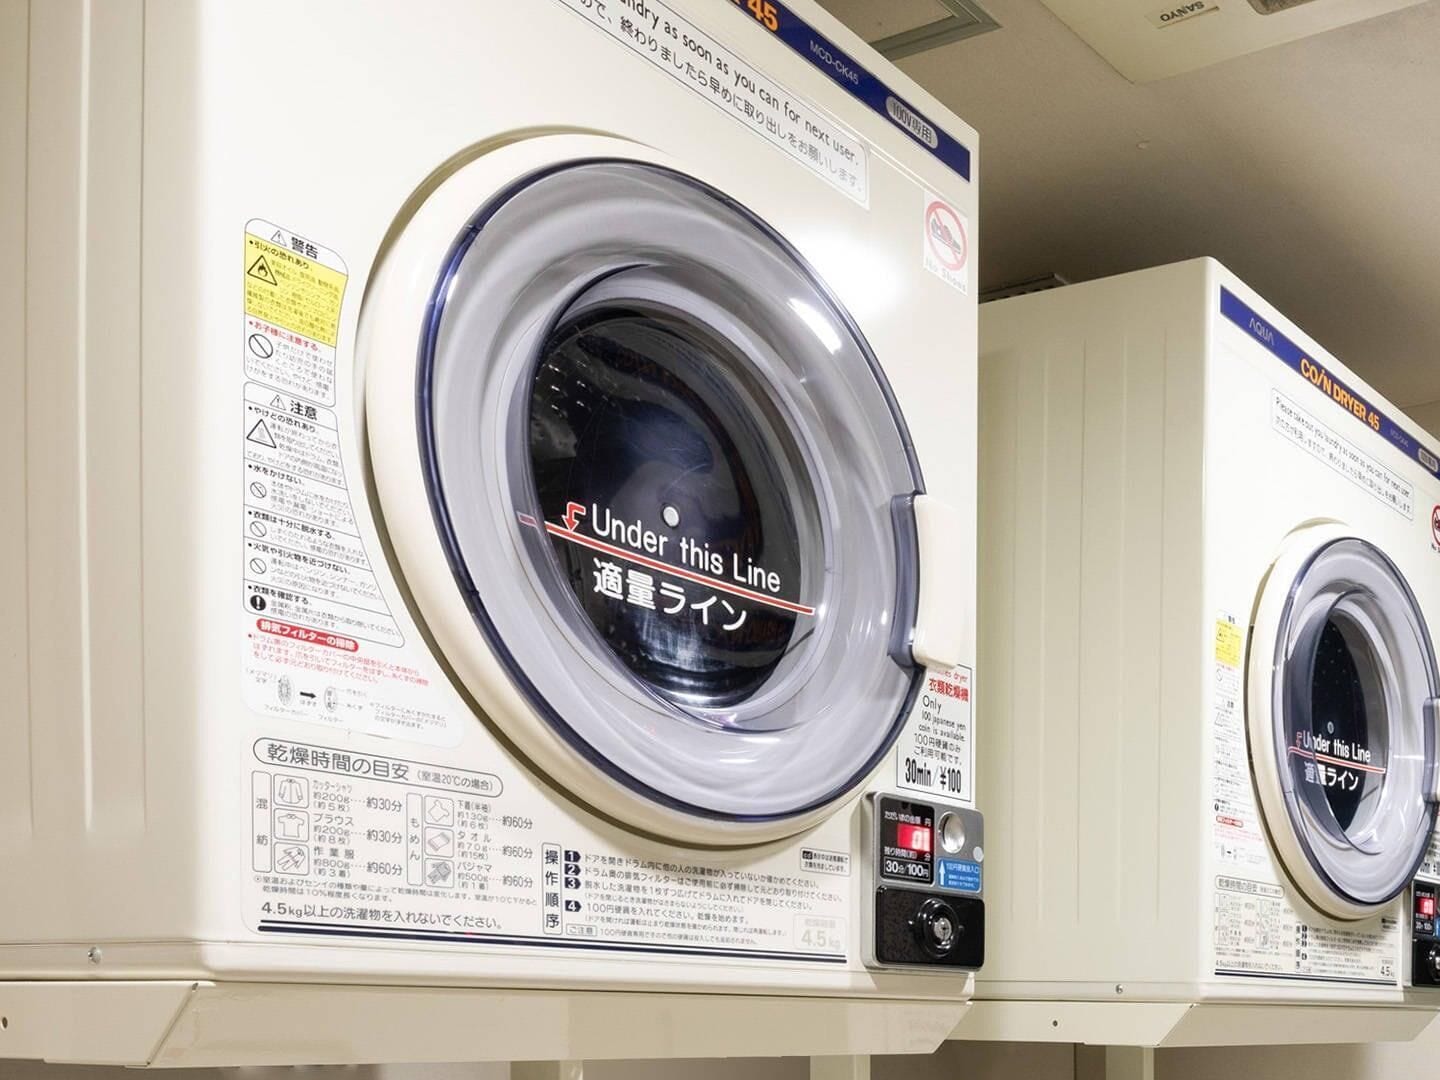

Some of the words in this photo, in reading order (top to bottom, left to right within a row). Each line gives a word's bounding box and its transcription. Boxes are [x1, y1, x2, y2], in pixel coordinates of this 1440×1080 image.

[748, 0, 778, 31] 45
[1160, 1, 1205, 22] SANYO
[664, 21, 678, 40] as
[682, 34, 712, 64] soon
[716, 57, 729, 76] as
[734, 69, 756, 95] you
[759, 88, 779, 111] can
[783, 102, 801, 123] for
[805, 119, 831, 146] next
[833, 138, 859, 166] user.
[291, 236, 319, 260] 警告
[290, 399, 318, 421] 注意
[1333, 382, 1367, 422] DRYER
[1367, 411, 1380, 432] 45
[592, 503, 669, 556] Under
[680, 537, 723, 575] this
[733, 553, 781, 593] Line
[593, 557, 747, 631] 適量ライン
[261, 619, 356, 651] 排気フィルターの掃除
[928, 678, 969, 702] 衣類乾燥機
[922, 694, 942, 714] Only
[921, 710, 931, 721] 100
[919, 723, 931, 733] coin
[933, 727, 938, 736] is
[1333, 739, 1350, 758] this
[1352, 743, 1371, 763] Line
[267, 742, 409, 781] 乾燥時間の目安
[366, 796, 402, 812] 約30分
[314, 813, 354, 826] ブラウス
[502, 815, 533, 830] 約60分
[366, 829, 402, 844] 約30分
[409, 818, 420, 861] もめん
[457, 831, 491, 843] タオル
[502, 845, 533, 859] 約60分
[367, 861, 402, 876] 約60分
[457, 860, 492, 872] パジャマ
[567, 864, 576, 875] 2
[502, 875, 533, 888] 約60分
[545, 849, 560, 929] 操作順序
[567, 878, 576, 889] 3
[261, 902, 502, 930] 4.5kg以上の洗濯物を入れないでください。
[567, 901, 576, 912] 4
